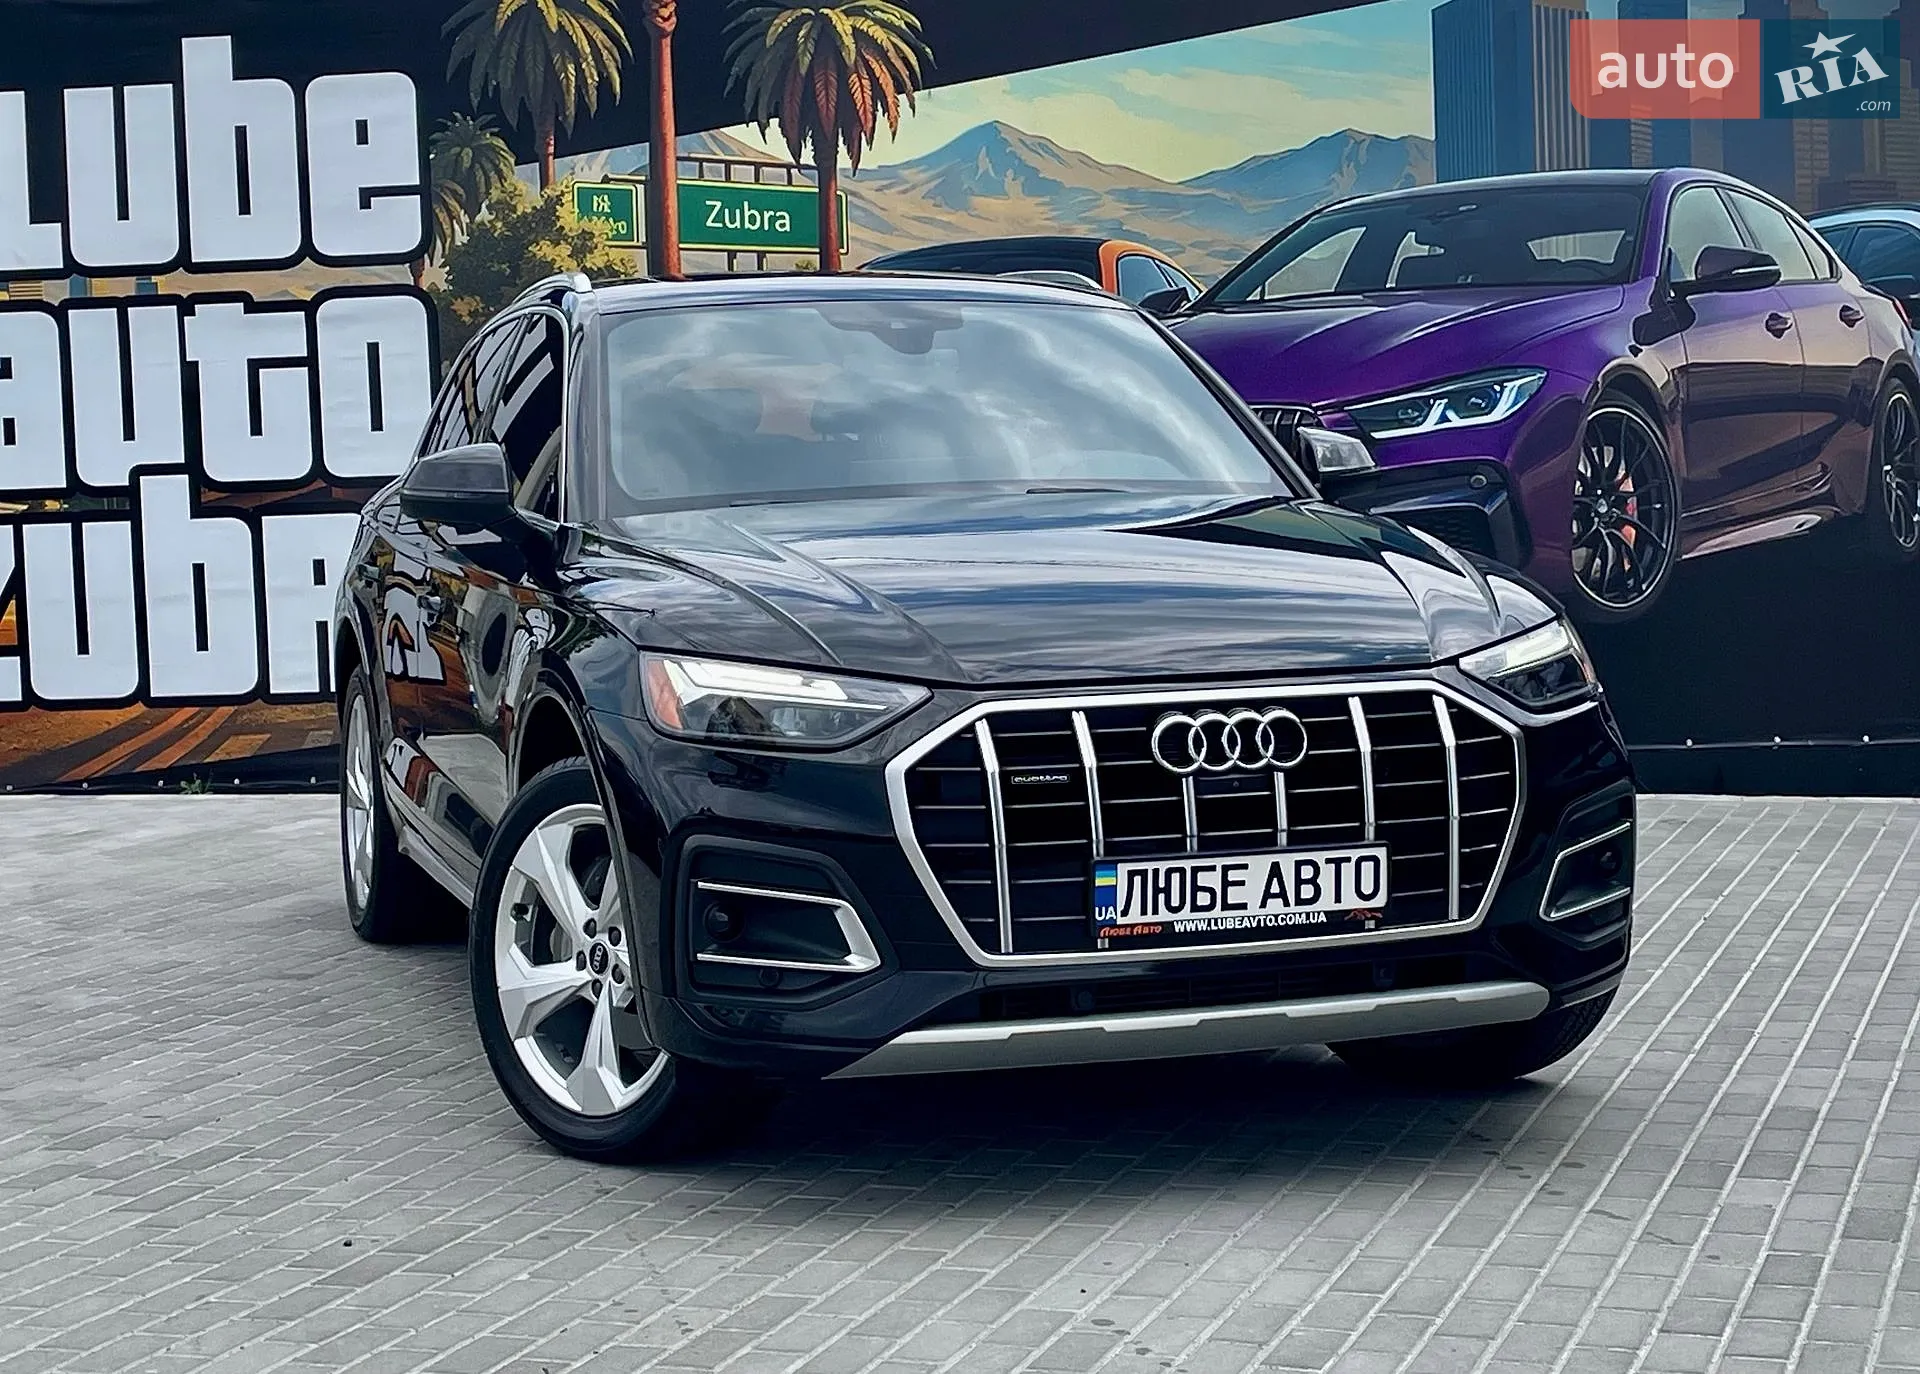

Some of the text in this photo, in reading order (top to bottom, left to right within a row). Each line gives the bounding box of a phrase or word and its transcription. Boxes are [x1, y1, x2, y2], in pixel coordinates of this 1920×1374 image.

[705, 200, 791, 232] Zubra
[0, 296, 434, 488] auto
[1120, 854, 1381, 918] ЛЮБЕ АВТО
[1095, 906, 1117, 921] UA
[1174, 911, 1327, 933] WWW.LUBEAVTO.COM.UA
